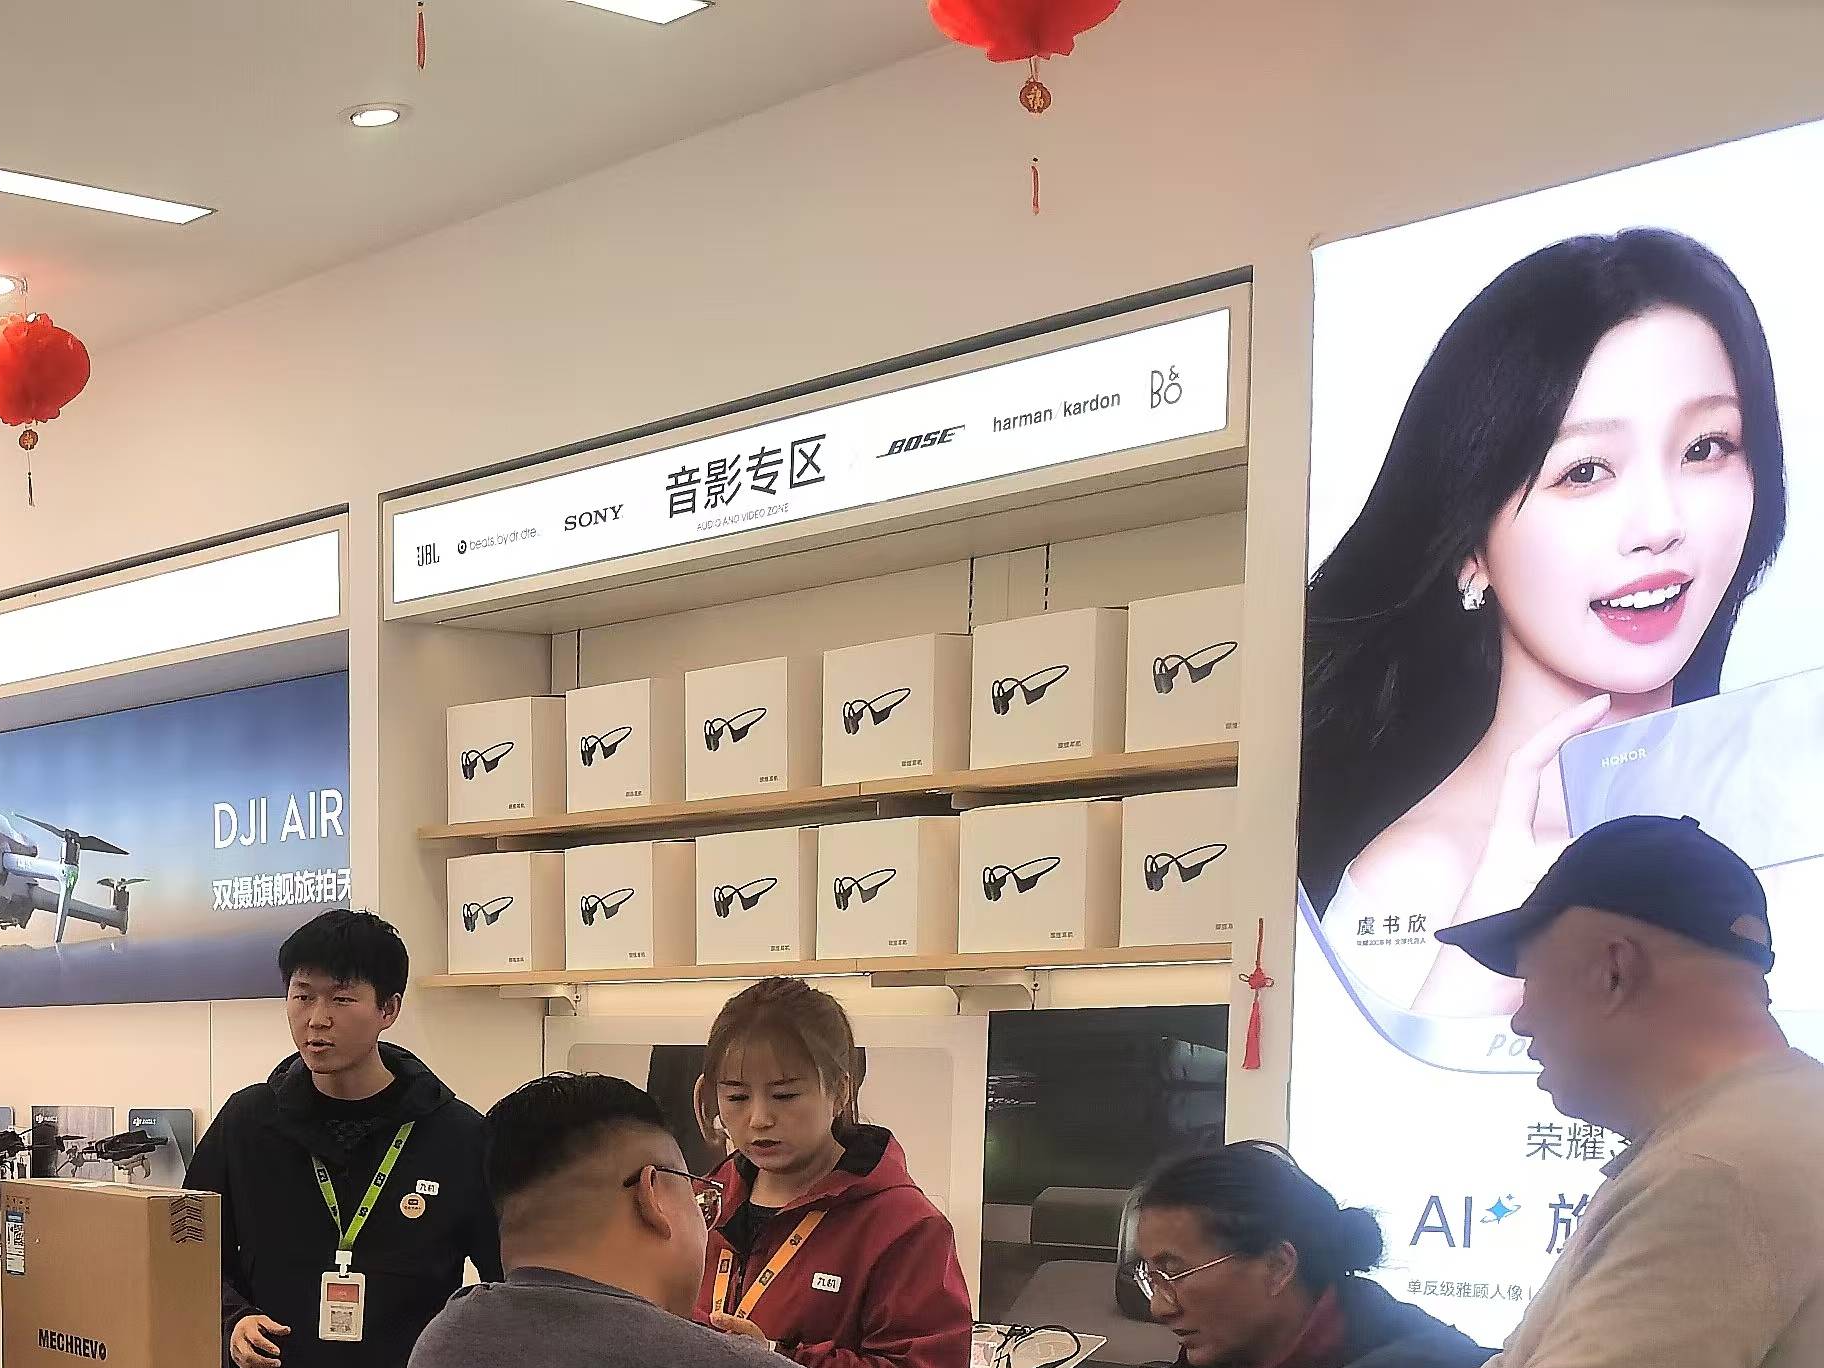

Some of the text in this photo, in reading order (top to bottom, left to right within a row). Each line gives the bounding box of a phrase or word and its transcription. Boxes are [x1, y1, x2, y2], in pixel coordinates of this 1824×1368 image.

[993, 392, 1121, 432] harman kardon
[878, 425, 964, 457] BOSE
[666, 434, 826, 518] 音影专区
[564, 504, 624, 532] SONY
[741, 509, 766, 523] VIDEO
[416, 542, 440, 567] JBL
[1601, 748, 1648, 768] HONOR
[213, 788, 344, 849] DJI AIR
[1356, 913, 1427, 936] 虞书欣
[1409, 1194, 1473, 1249] AI
[1407, 1279, 1523, 1301] 单反级雅顾人像
[37, 1328, 108, 1362] MECHREVO
